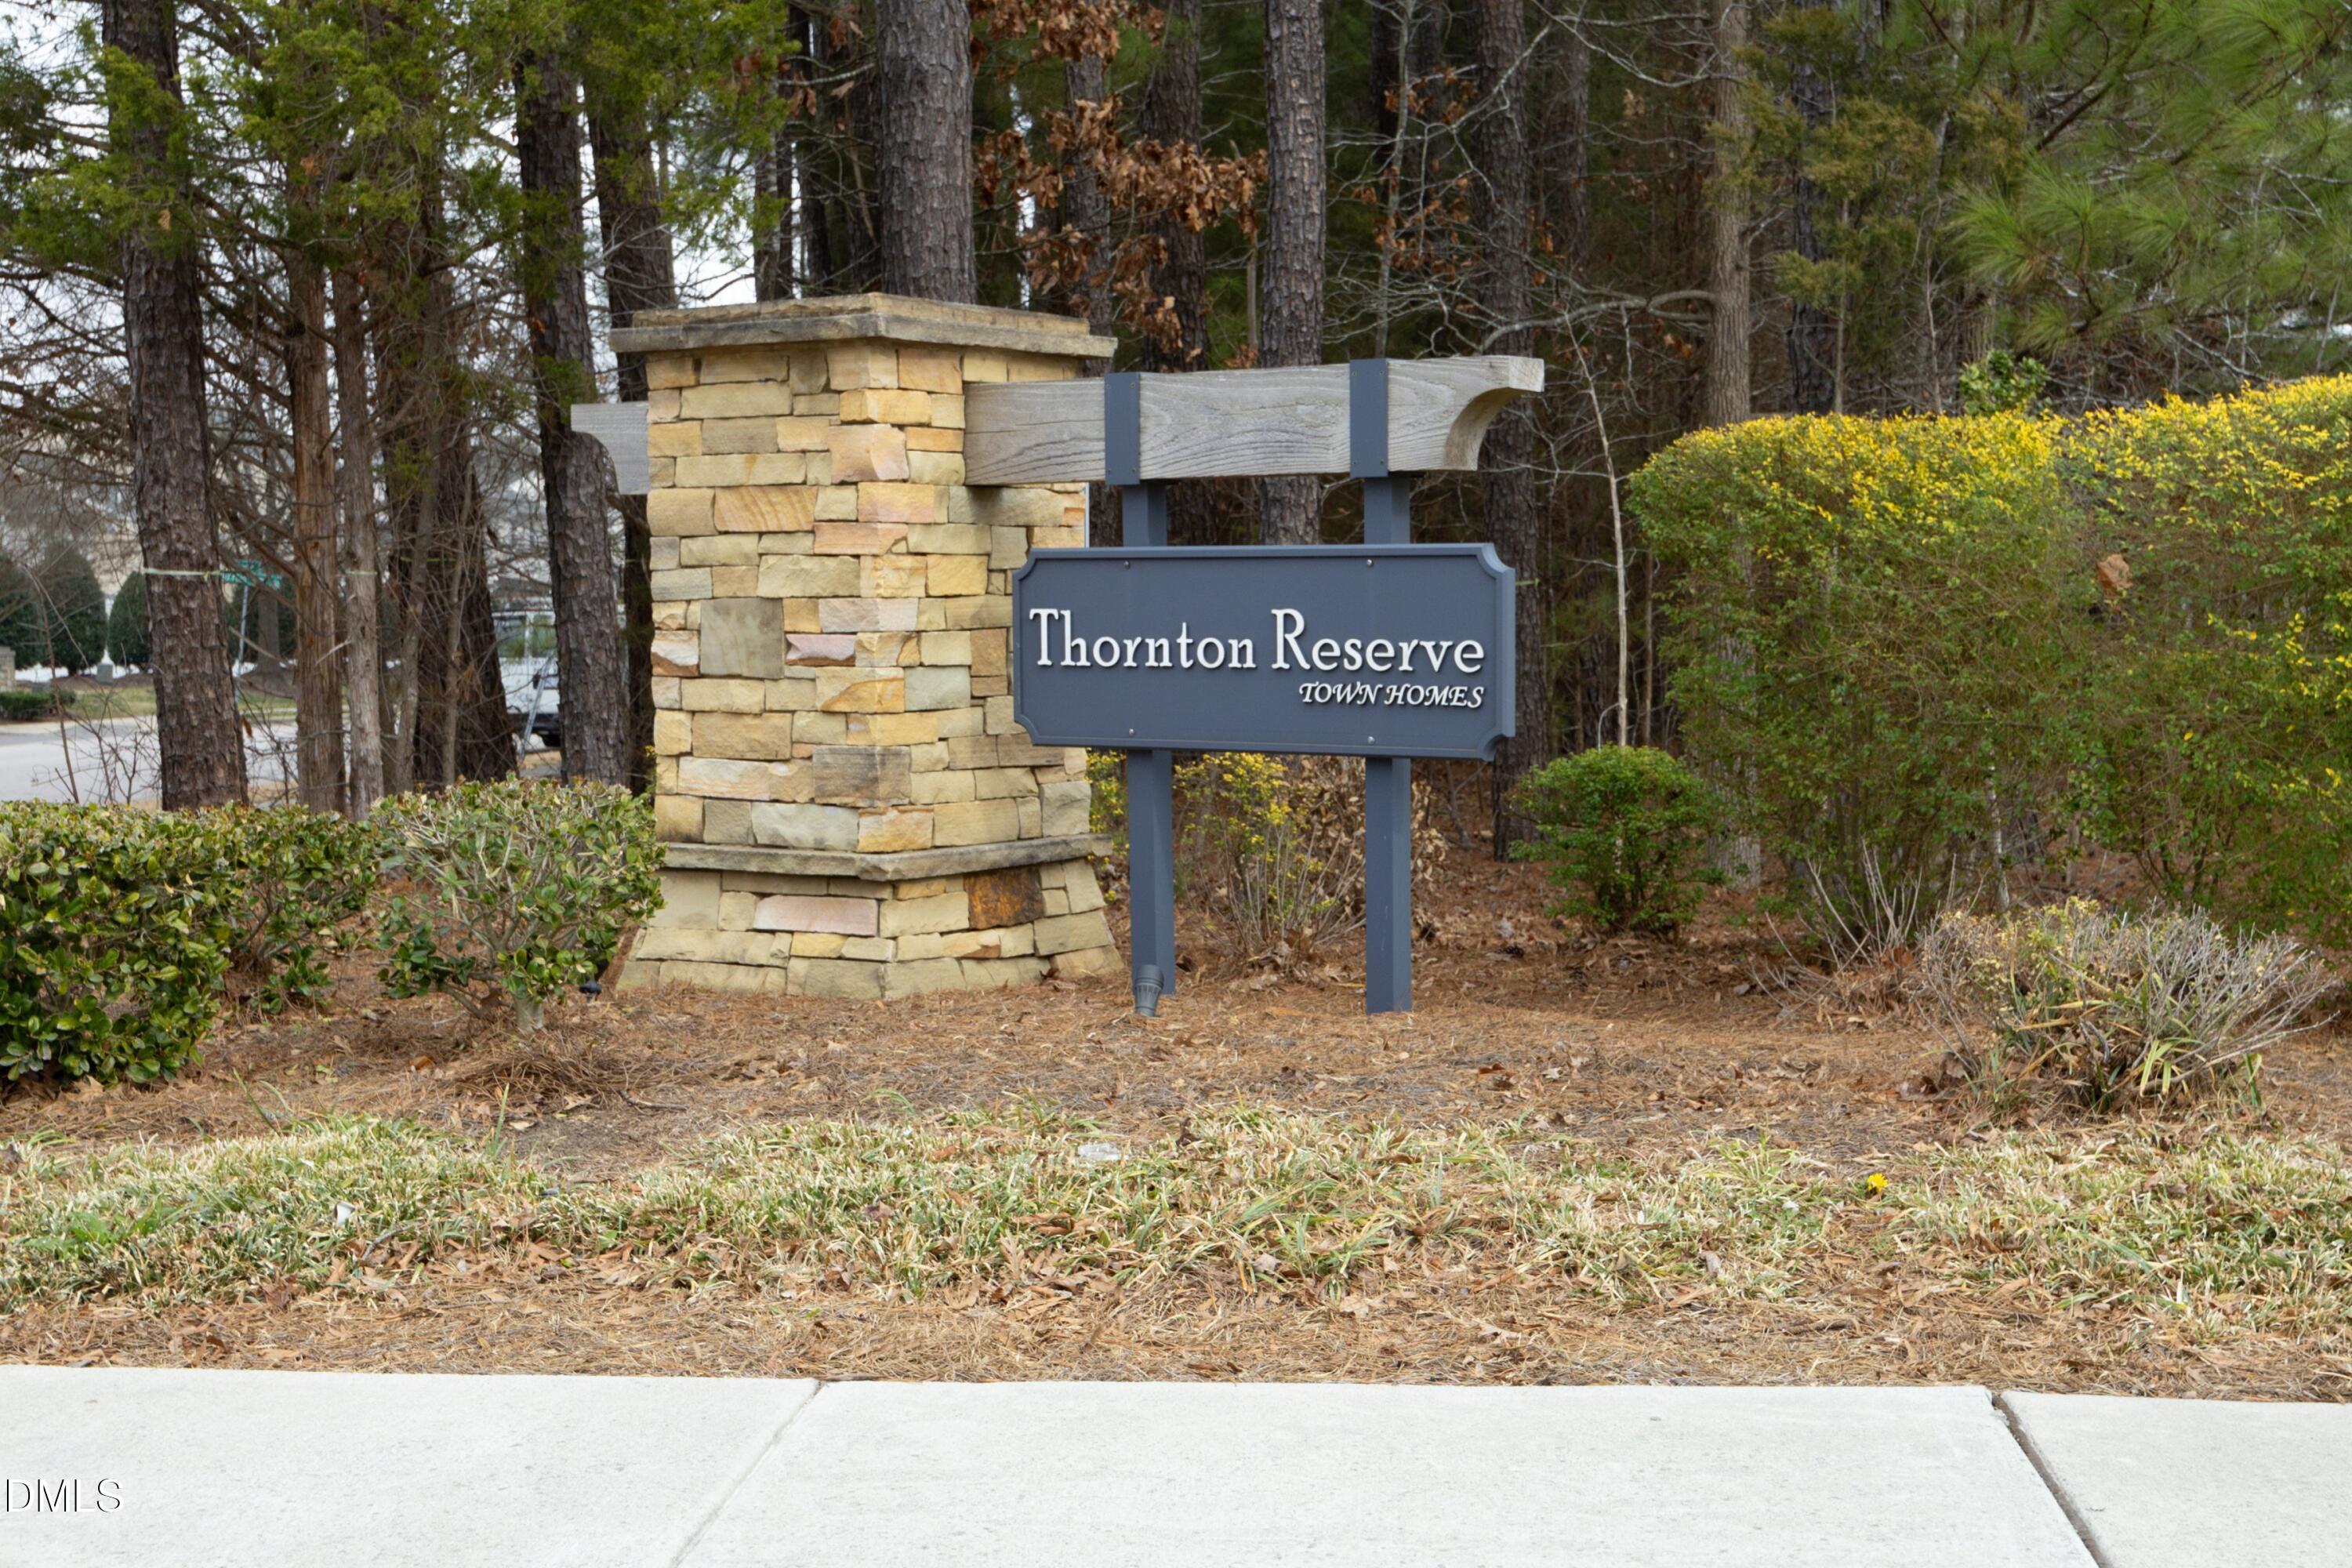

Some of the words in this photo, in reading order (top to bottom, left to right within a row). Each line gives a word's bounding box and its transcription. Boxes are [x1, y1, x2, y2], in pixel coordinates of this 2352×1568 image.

[1029, 608, 1257, 670] Thornton
[1270, 608, 1485, 673] Reserve
[1298, 681, 1383, 706] TOWN
[1384, 683, 1485, 709] HOMES
